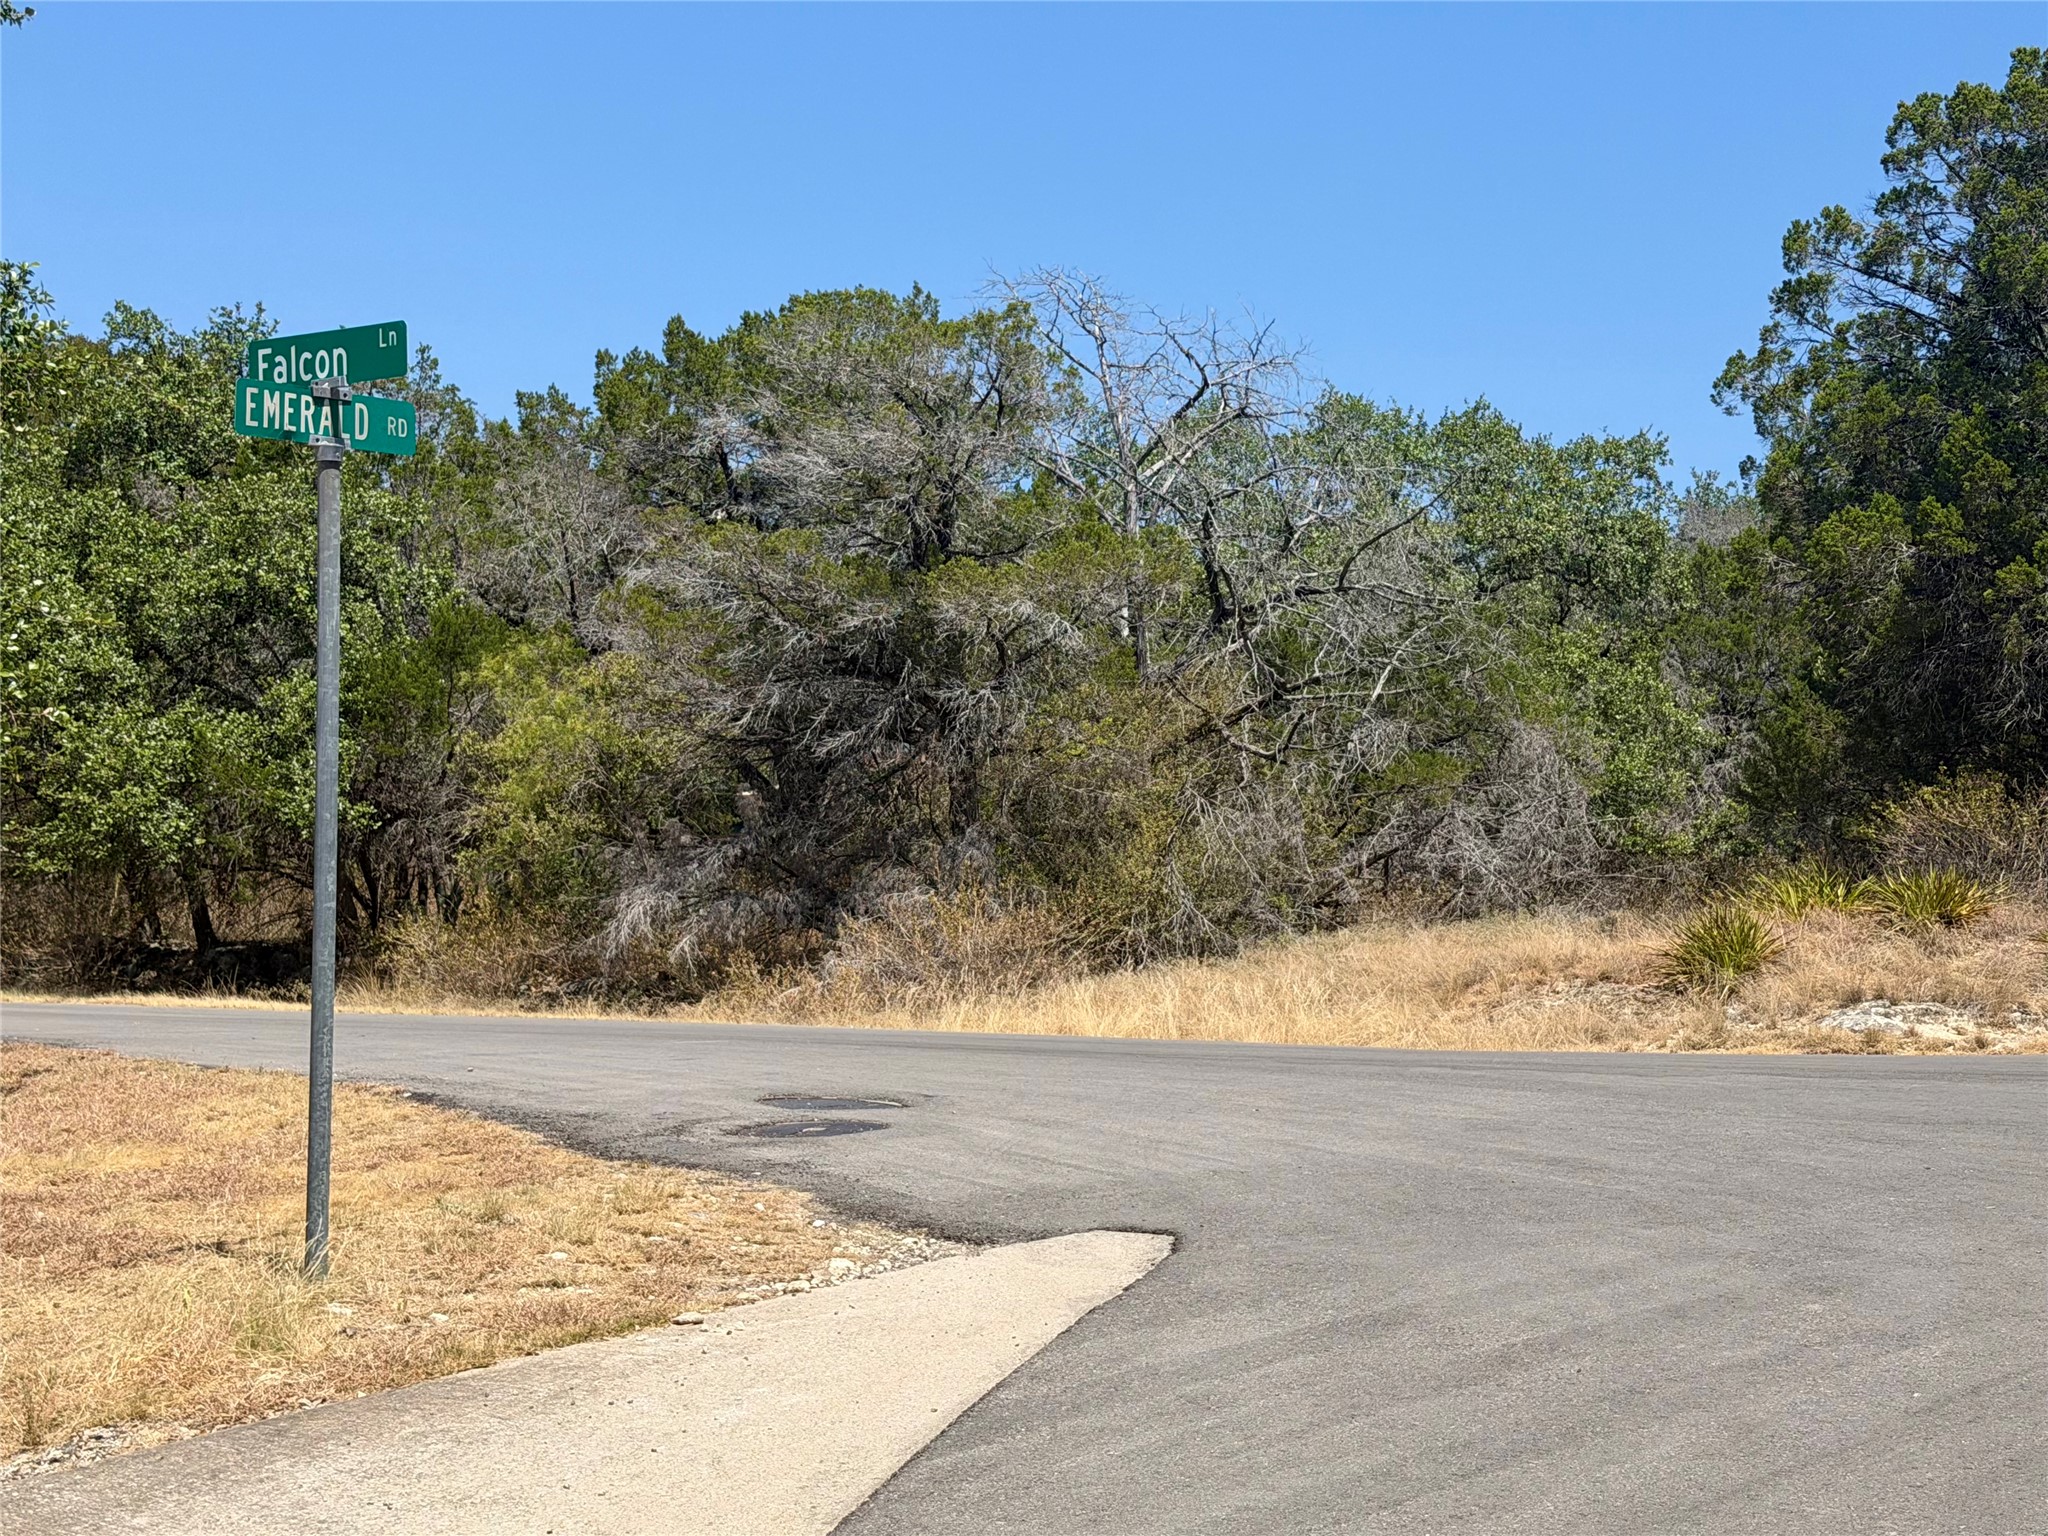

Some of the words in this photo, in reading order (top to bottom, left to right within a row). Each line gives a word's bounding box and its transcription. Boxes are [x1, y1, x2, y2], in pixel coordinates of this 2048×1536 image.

[258, 345, 348, 384] Falcon
[379, 328, 397, 348] Ln
[245, 387, 369, 441] EMERALD
[387, 416, 408, 438] RD
